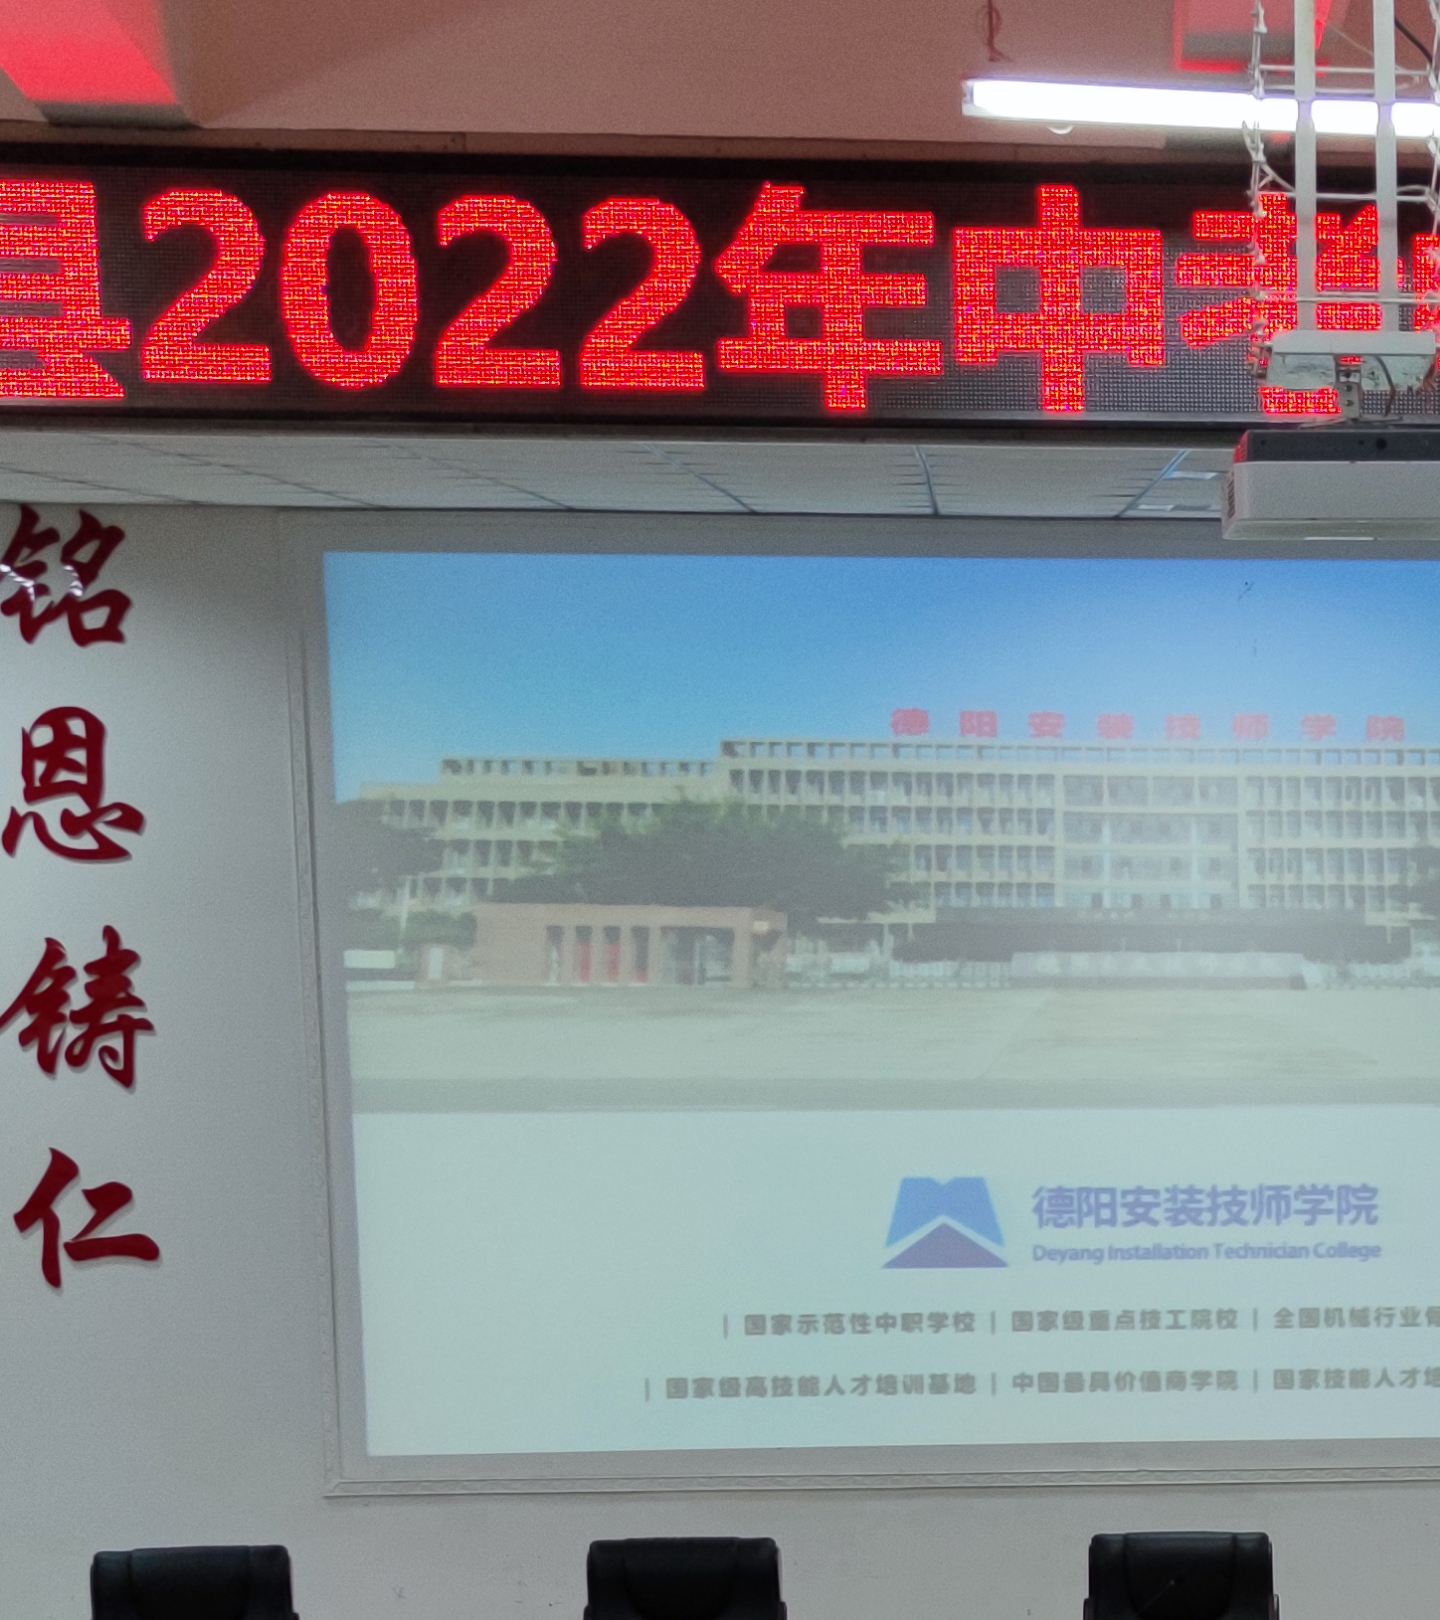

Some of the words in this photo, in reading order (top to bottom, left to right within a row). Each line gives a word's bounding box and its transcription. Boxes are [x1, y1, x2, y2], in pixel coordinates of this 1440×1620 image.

[1032, 1183, 1381, 1229] 德阳安装技师学院
[1032, 1244, 1104, 1265] Deyang
[1108, 1242, 1208, 1262] Installation
[1213, 1241, 1310, 1260] Technician
[1313, 1240, 1382, 1262] College
